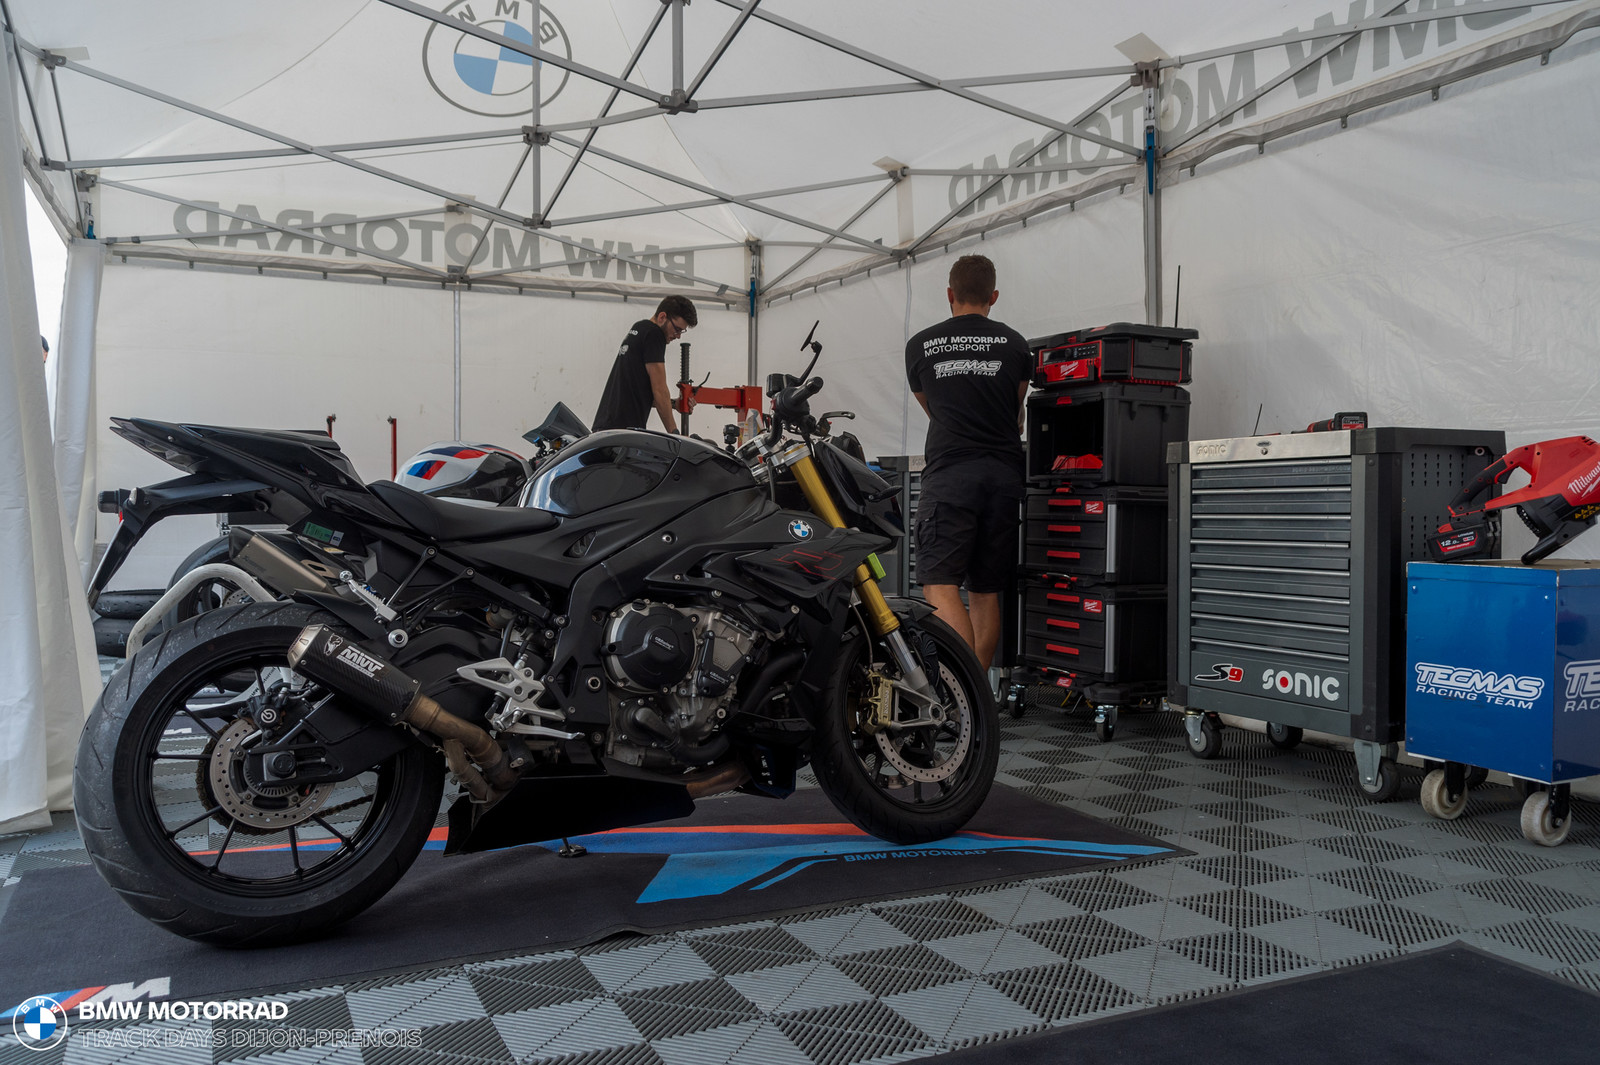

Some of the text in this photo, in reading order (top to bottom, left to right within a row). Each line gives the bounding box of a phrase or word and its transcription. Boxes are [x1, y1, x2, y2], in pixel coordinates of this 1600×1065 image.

[923, 336, 1008, 350] BMW MOTORRAD
[924, 343, 991, 358] MOTORSPORT
[933, 359, 1002, 374] TECMAS
[935, 370, 969, 379] RACING
[1195, 663, 1340, 701] S9 SONIC
[1415, 662, 1545, 701] TECMAS
[1416, 685, 1534, 710] RACING TEAM
[844, 849, 986, 862] BMW MOTORRAD
